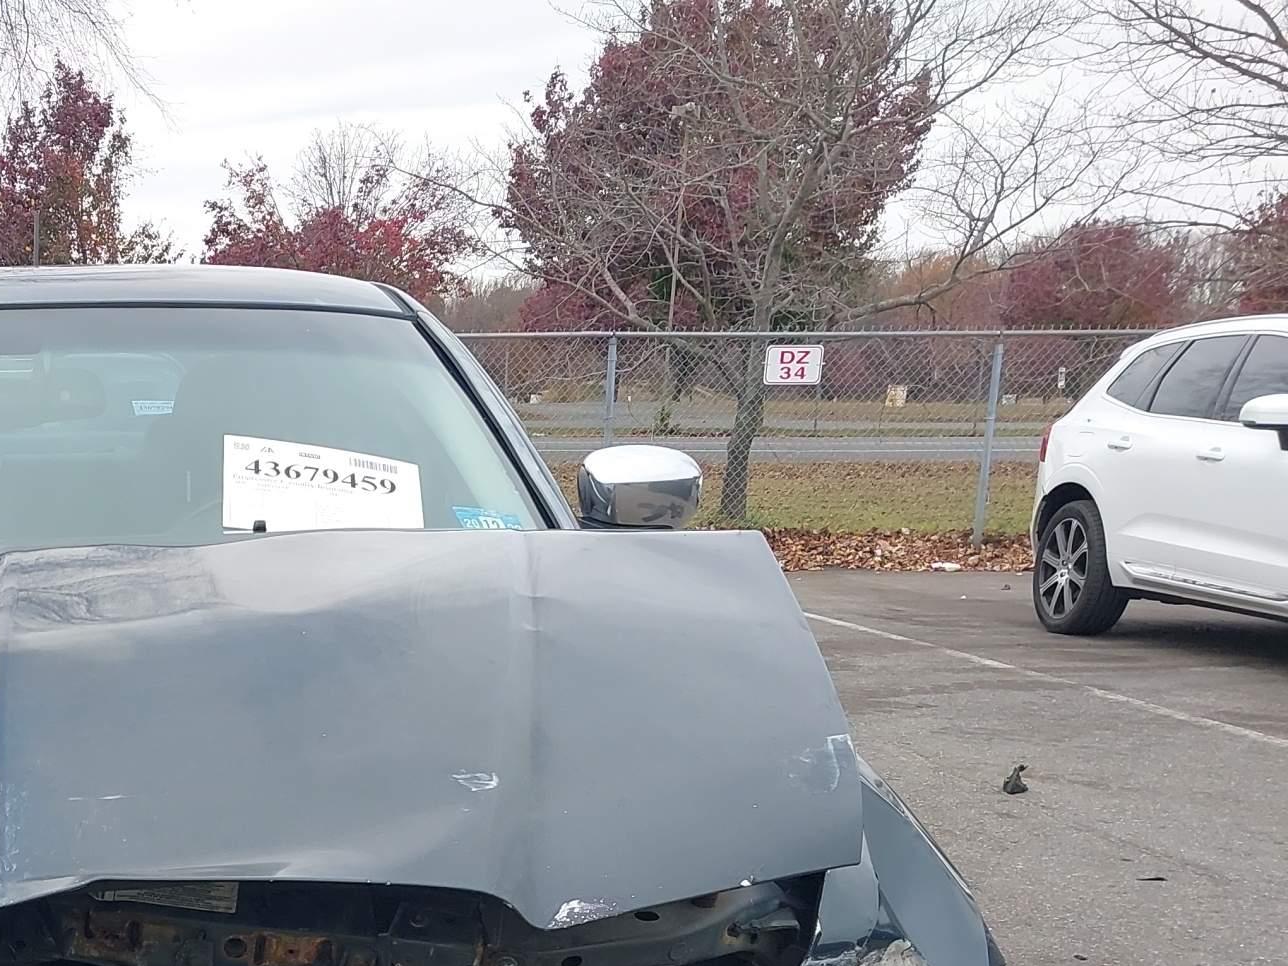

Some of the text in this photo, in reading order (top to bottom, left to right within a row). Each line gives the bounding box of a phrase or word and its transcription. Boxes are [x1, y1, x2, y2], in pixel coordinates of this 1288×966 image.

[779, 350, 811, 365] DZ
[779, 366, 807, 380] 34
[244, 458, 397, 495] 43679459
